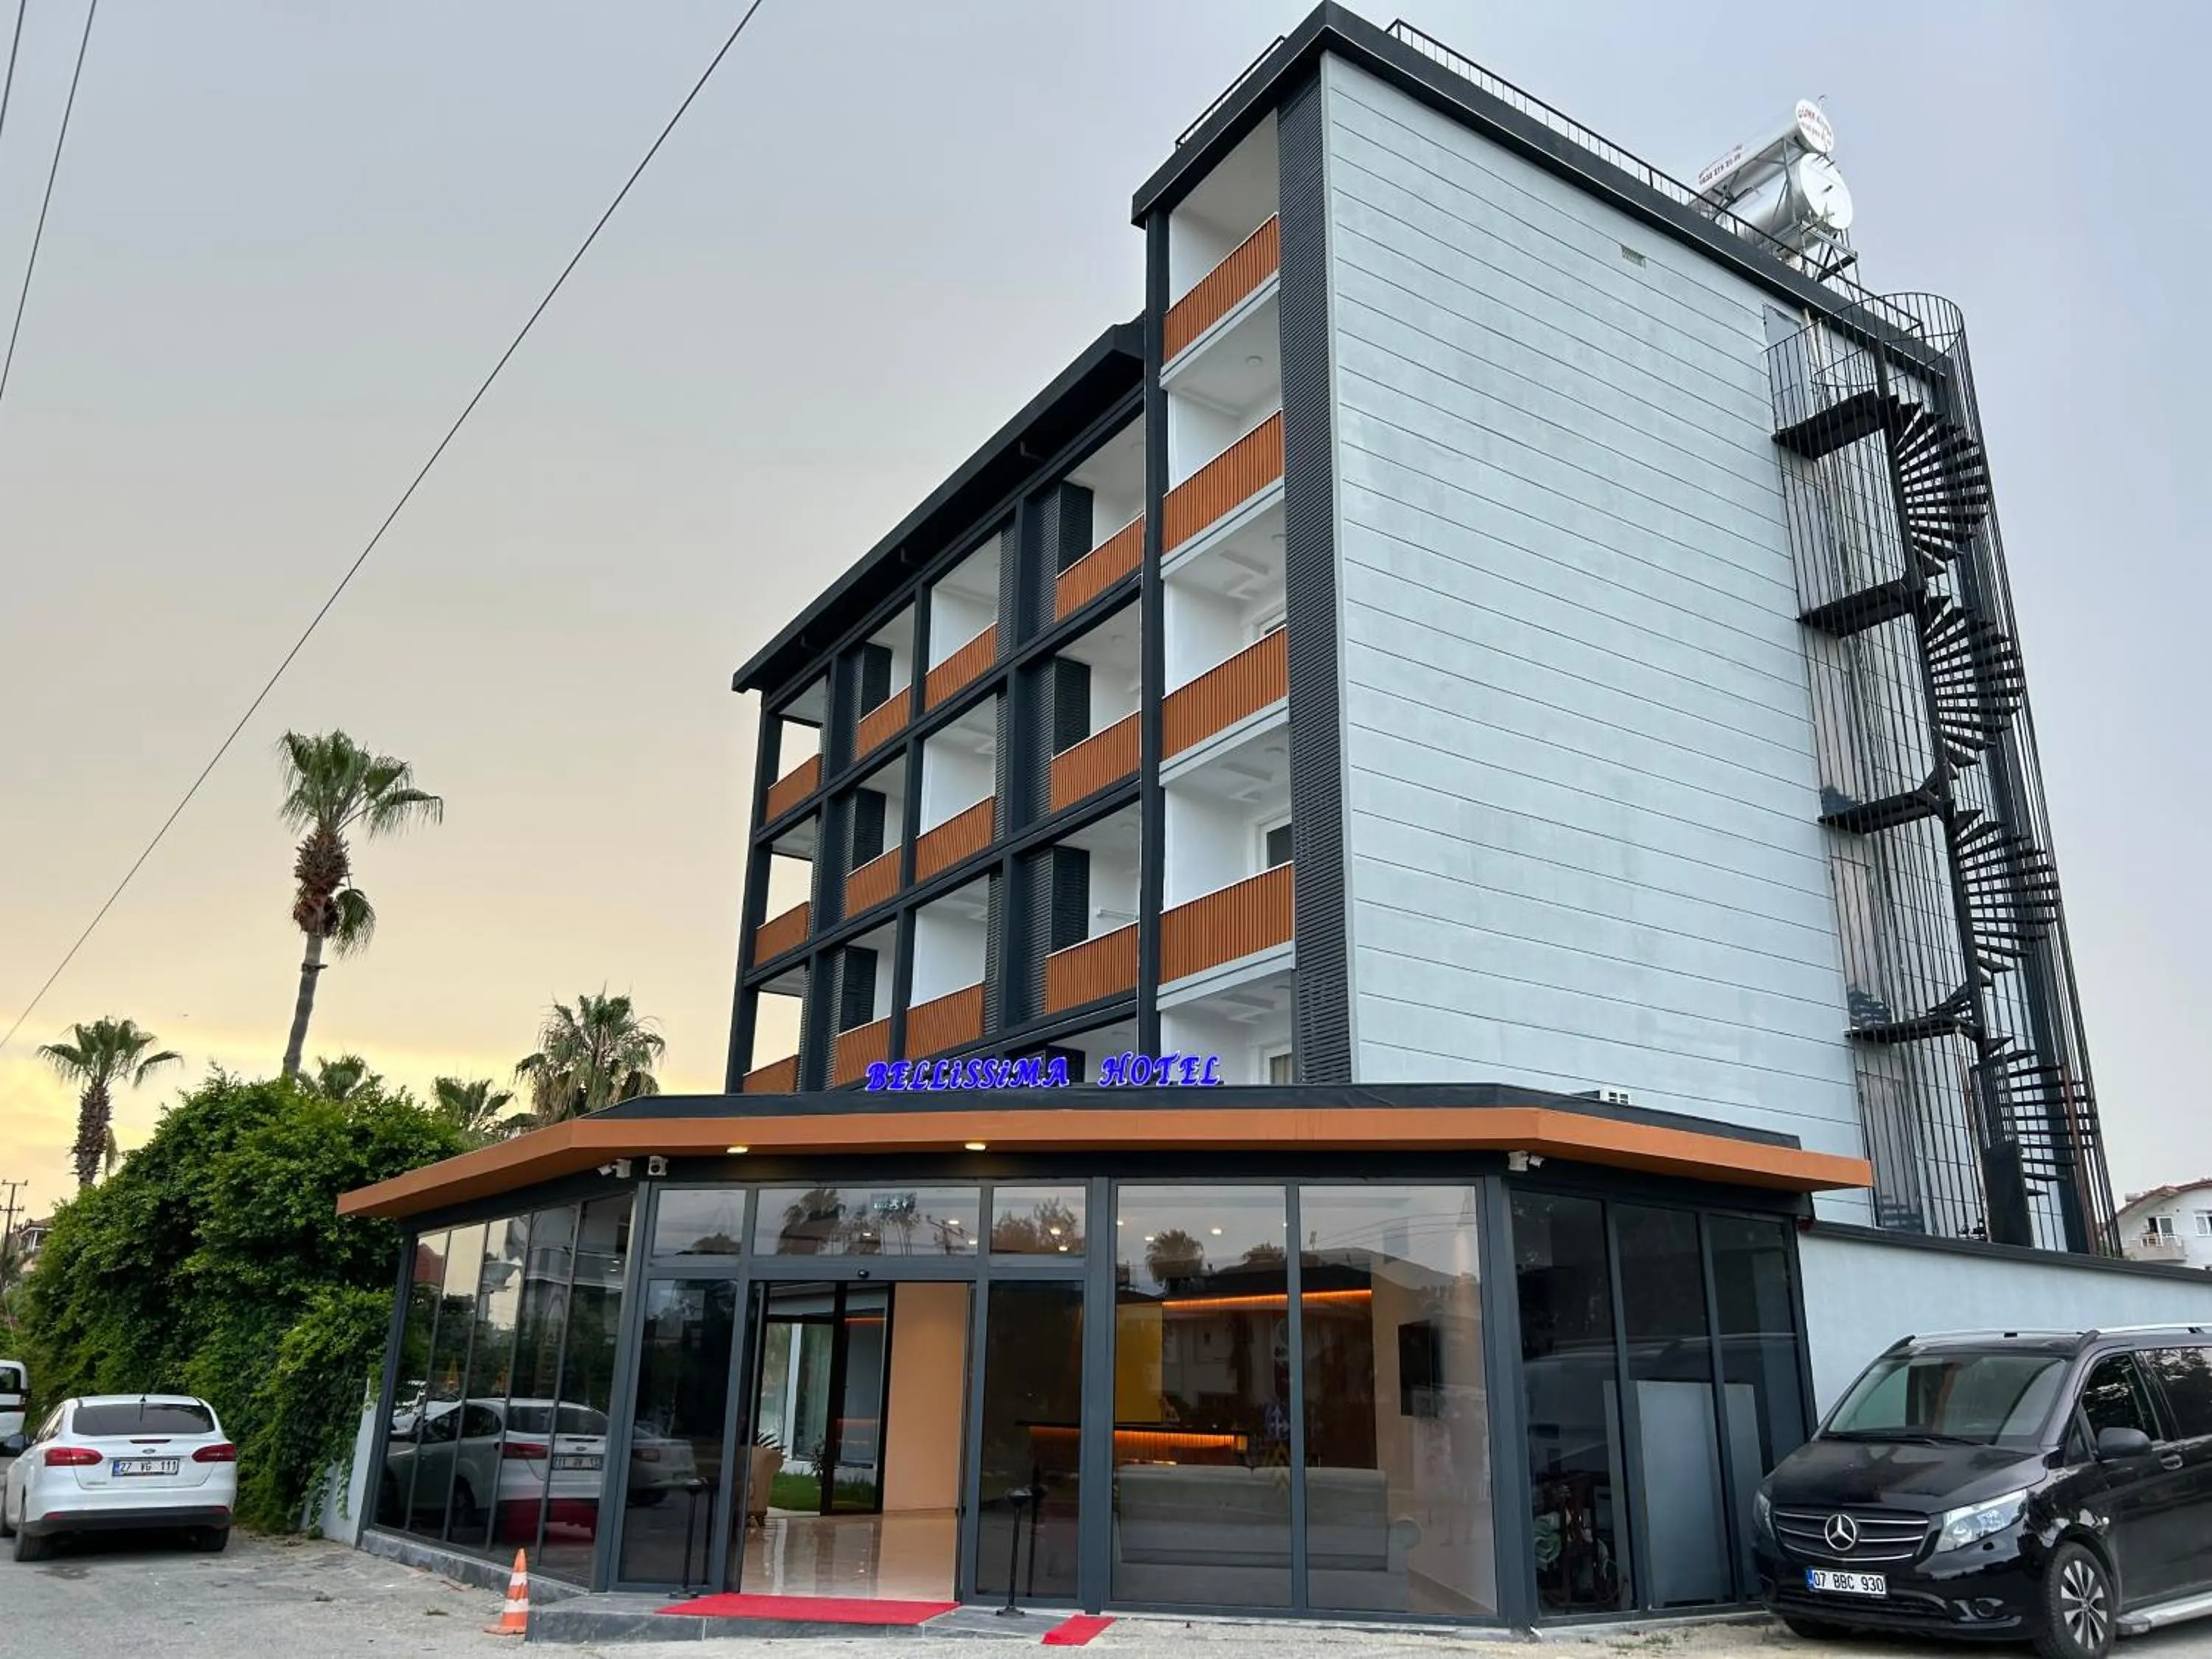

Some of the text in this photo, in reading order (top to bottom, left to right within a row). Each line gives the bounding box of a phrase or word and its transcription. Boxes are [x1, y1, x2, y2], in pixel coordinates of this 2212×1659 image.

[1099, 1051, 1221, 1087] HOTEL
[120, 1462, 133, 1472] 27
[161, 1461, 176, 1471] 111
[1813, 1572, 1826, 1587] 07
[1833, 1574, 1855, 1590] BBC
[1860, 1576, 1884, 1592] 930
